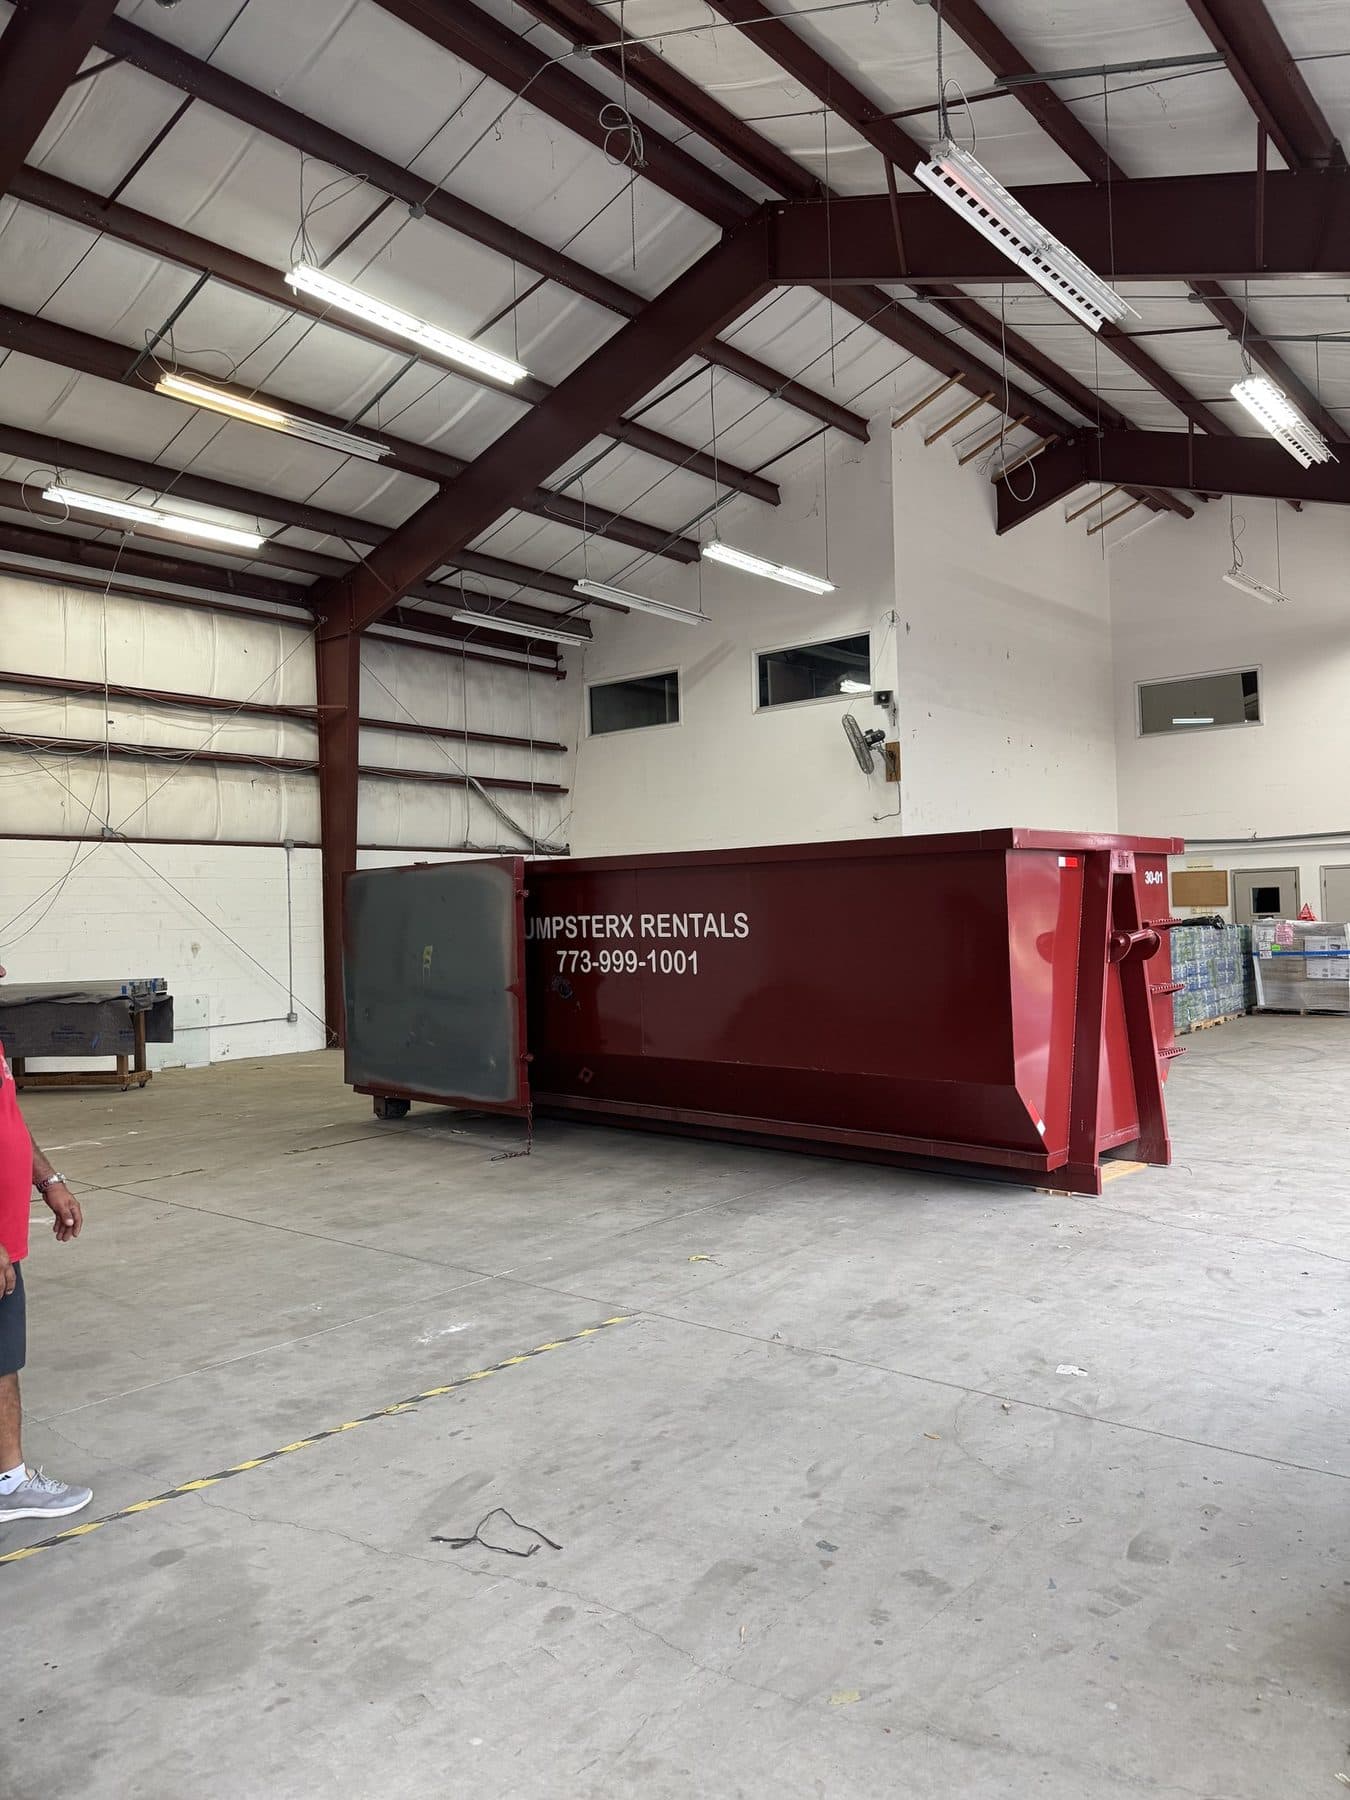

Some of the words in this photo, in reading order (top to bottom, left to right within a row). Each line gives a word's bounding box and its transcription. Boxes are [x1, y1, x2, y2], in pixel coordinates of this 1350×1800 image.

[1144, 870, 1163, 885] 30-01
[640, 912, 749, 938] RENTALS
[556, 949, 698, 975] 773-999-1001
